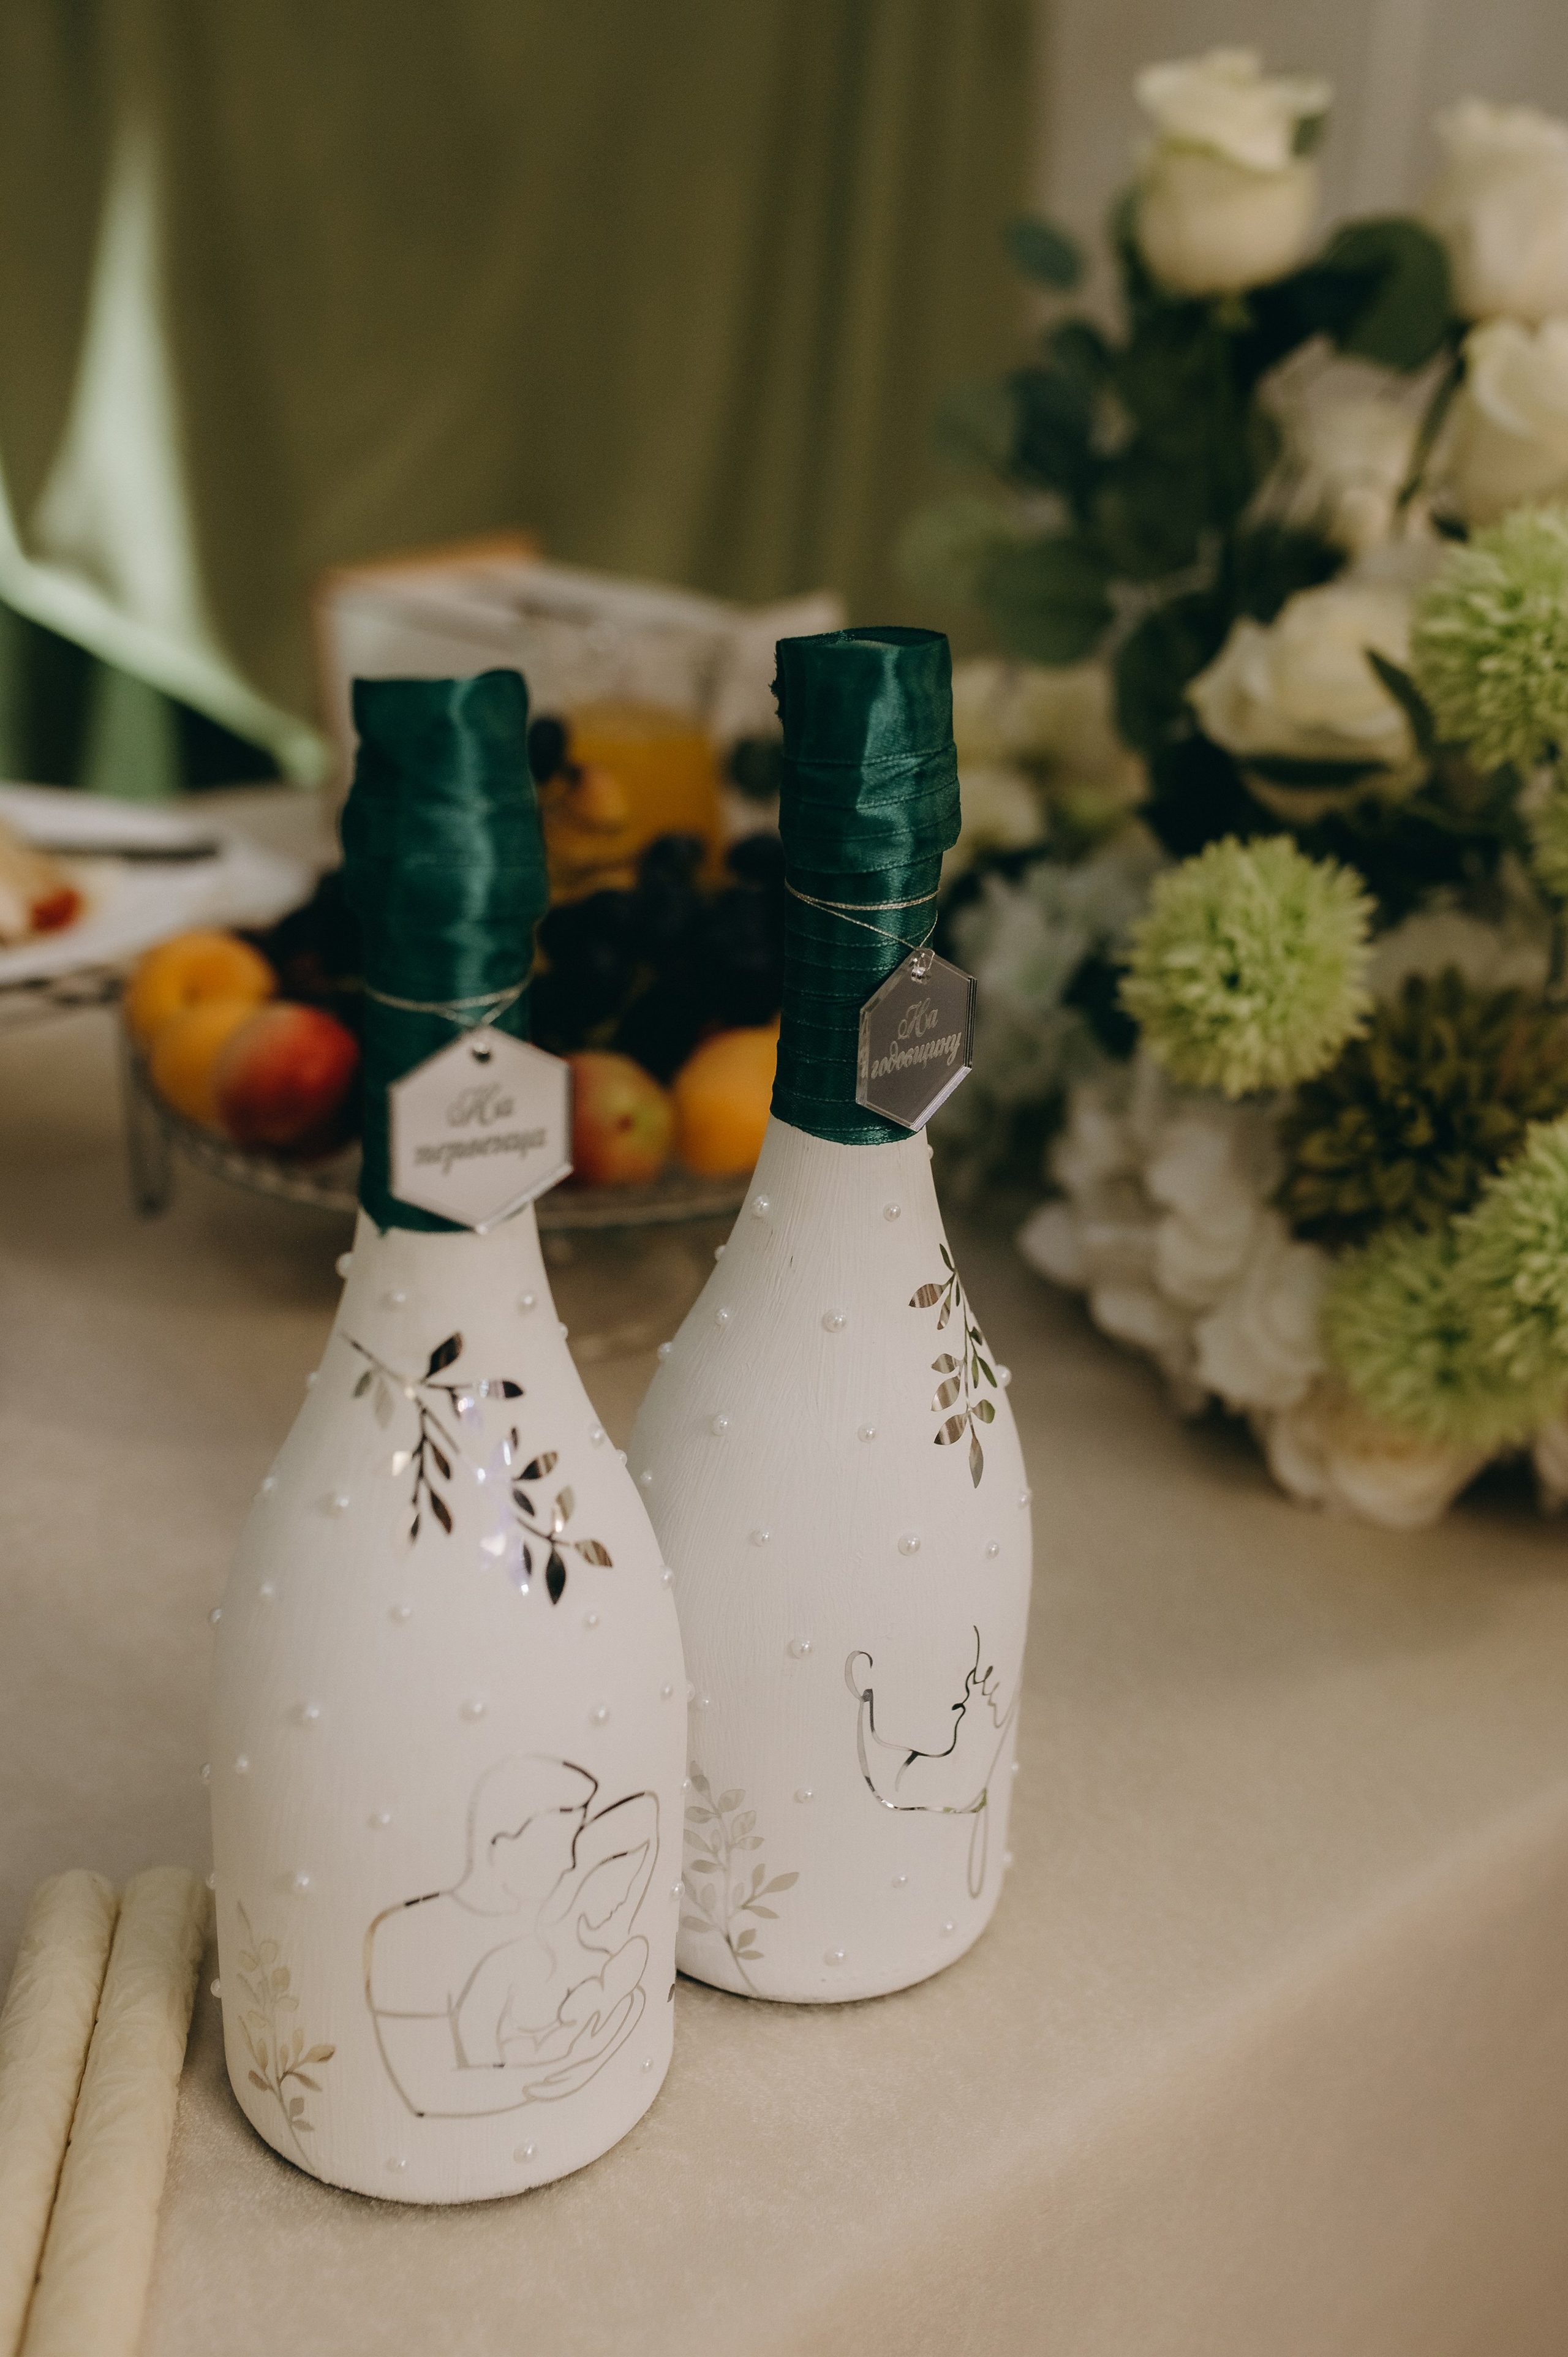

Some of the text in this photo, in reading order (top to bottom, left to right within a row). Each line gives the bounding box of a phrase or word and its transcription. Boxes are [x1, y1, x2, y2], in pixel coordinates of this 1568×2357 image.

[898, 998, 939, 1039] На
[870, 1032, 962, 1079] годовщину
[447, 1082, 515, 1128] На
